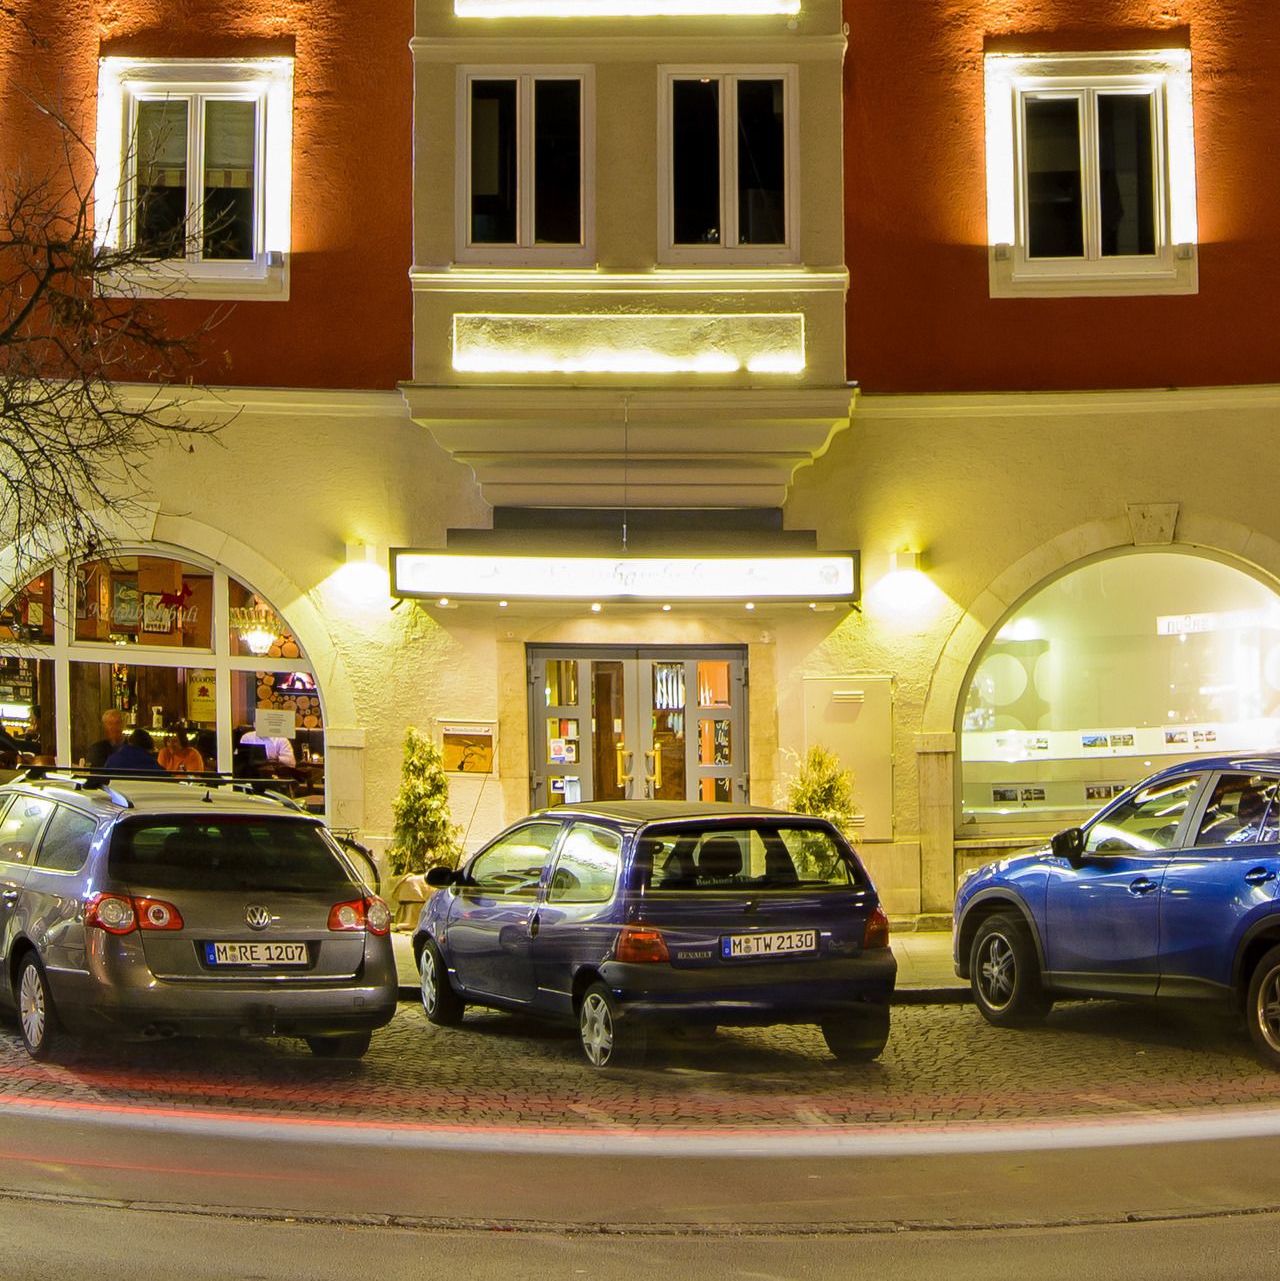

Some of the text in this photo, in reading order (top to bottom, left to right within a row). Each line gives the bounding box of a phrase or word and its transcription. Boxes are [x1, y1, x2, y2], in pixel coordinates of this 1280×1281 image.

[732, 940, 742, 954] M
[753, 936, 773, 952] TW
[776, 932, 814, 951] 2130
[216, 945, 228, 961] M
[238, 945, 260, 961] RE
[264, 945, 305, 961] 1207
